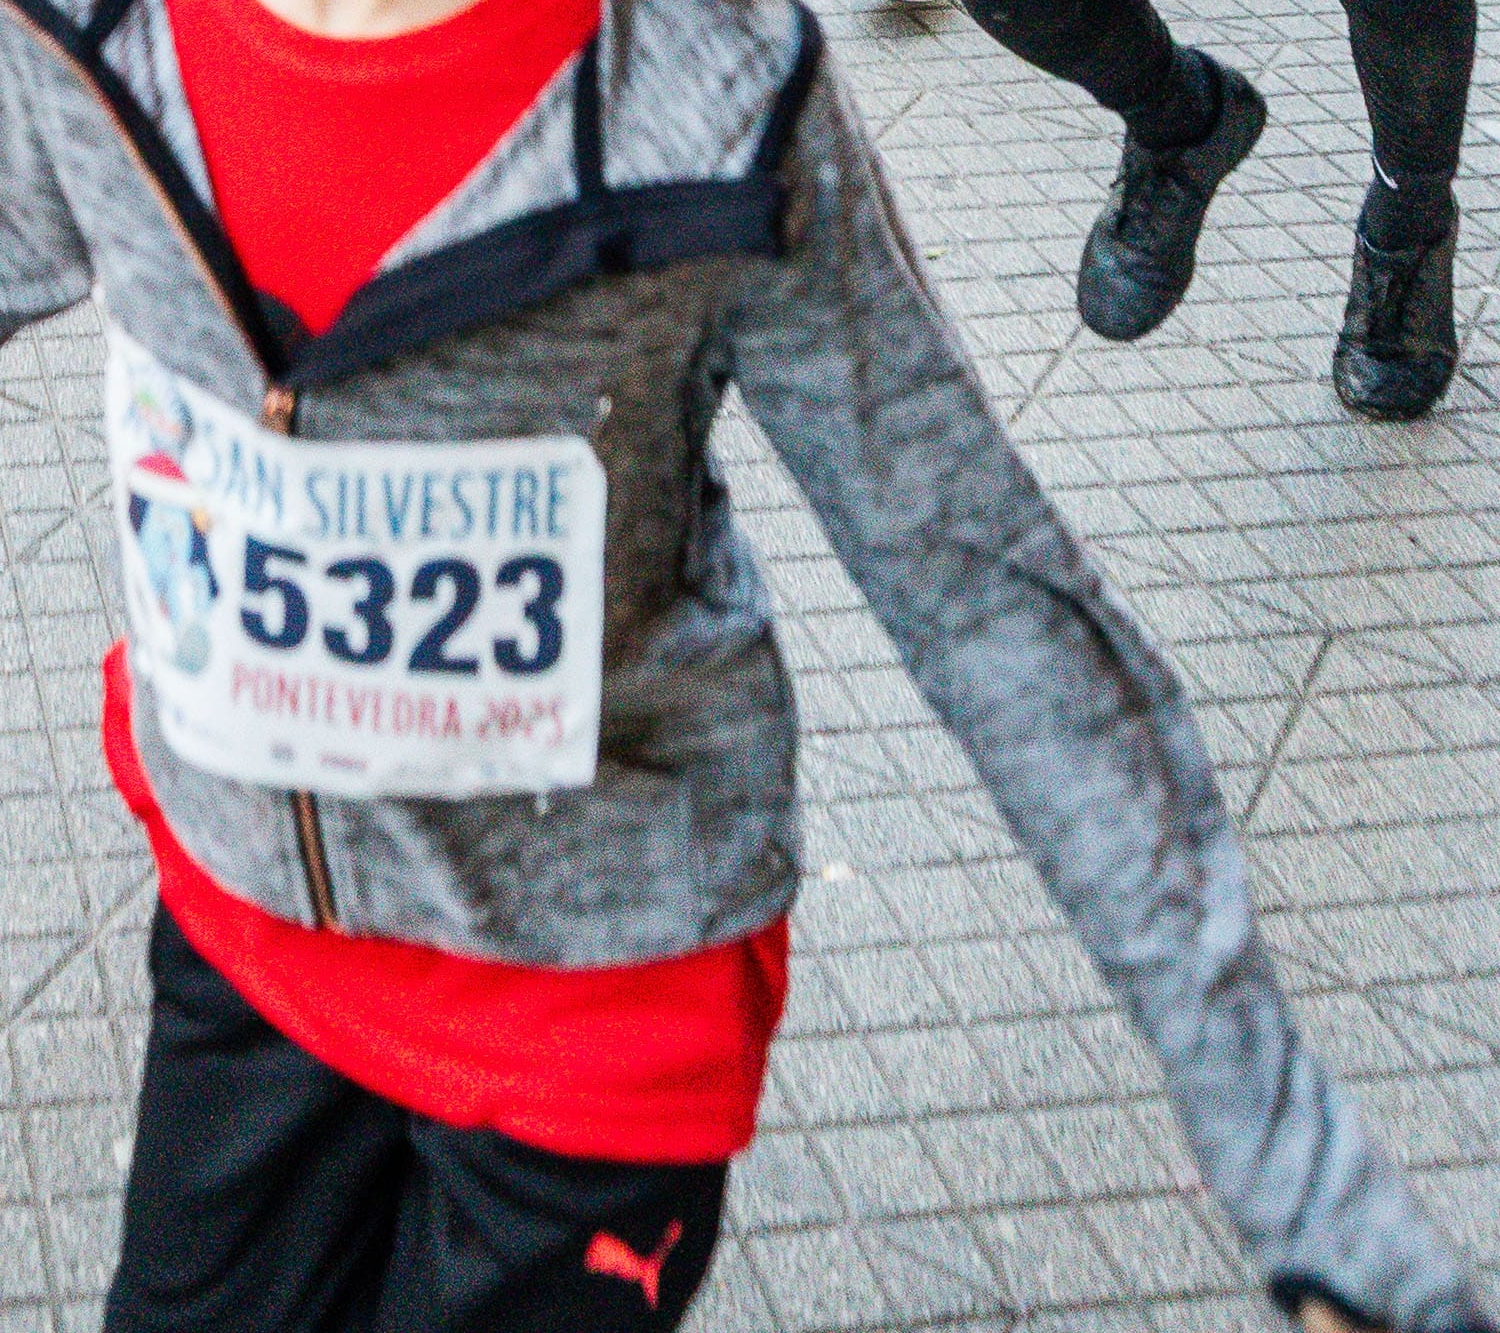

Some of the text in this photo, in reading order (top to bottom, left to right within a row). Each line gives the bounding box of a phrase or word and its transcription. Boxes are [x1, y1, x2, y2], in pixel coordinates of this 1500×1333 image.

[203, 441, 569, 538] SAN SILVESTRE
[238, 537, 566, 676] 5323
[230, 663, 462, 739] PONTEVEDRA
